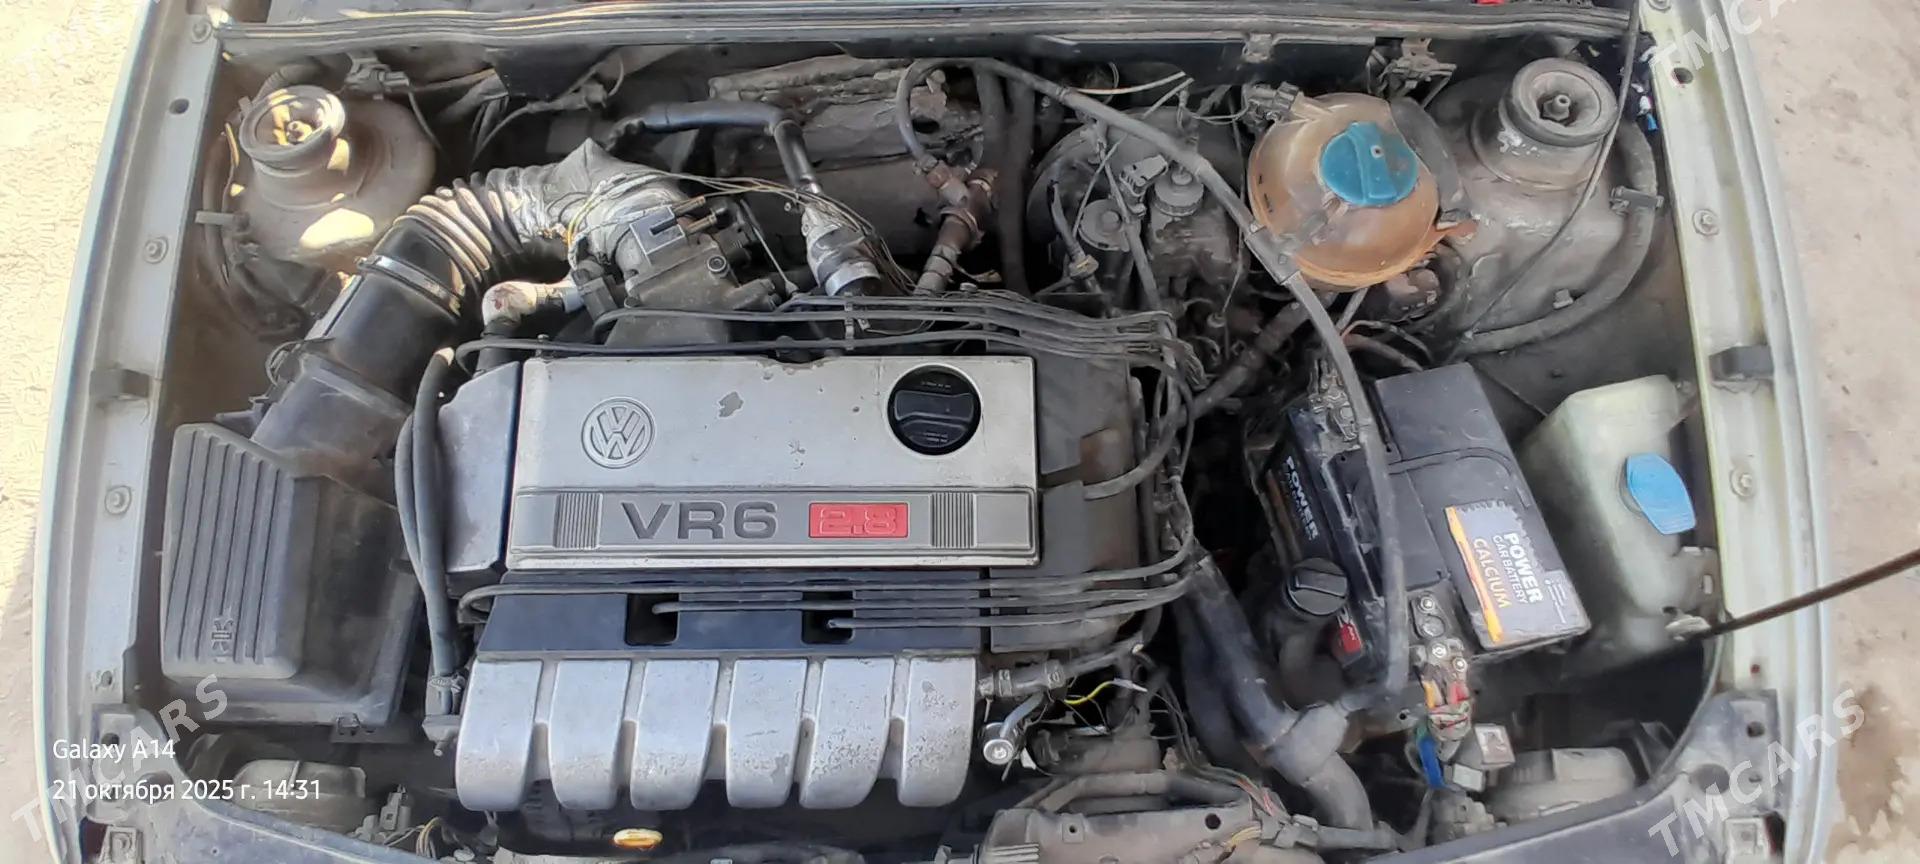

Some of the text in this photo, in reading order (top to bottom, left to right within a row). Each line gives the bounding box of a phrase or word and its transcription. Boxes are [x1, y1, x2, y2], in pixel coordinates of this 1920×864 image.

[621, 501, 898, 540] VR6 2.8
[1286, 455, 1319, 540] POWER
[1473, 537, 1513, 609] CALCIUM
[1492, 535, 1530, 604] CAR BATTERY
[1503, 532, 1544, 603] POWER
